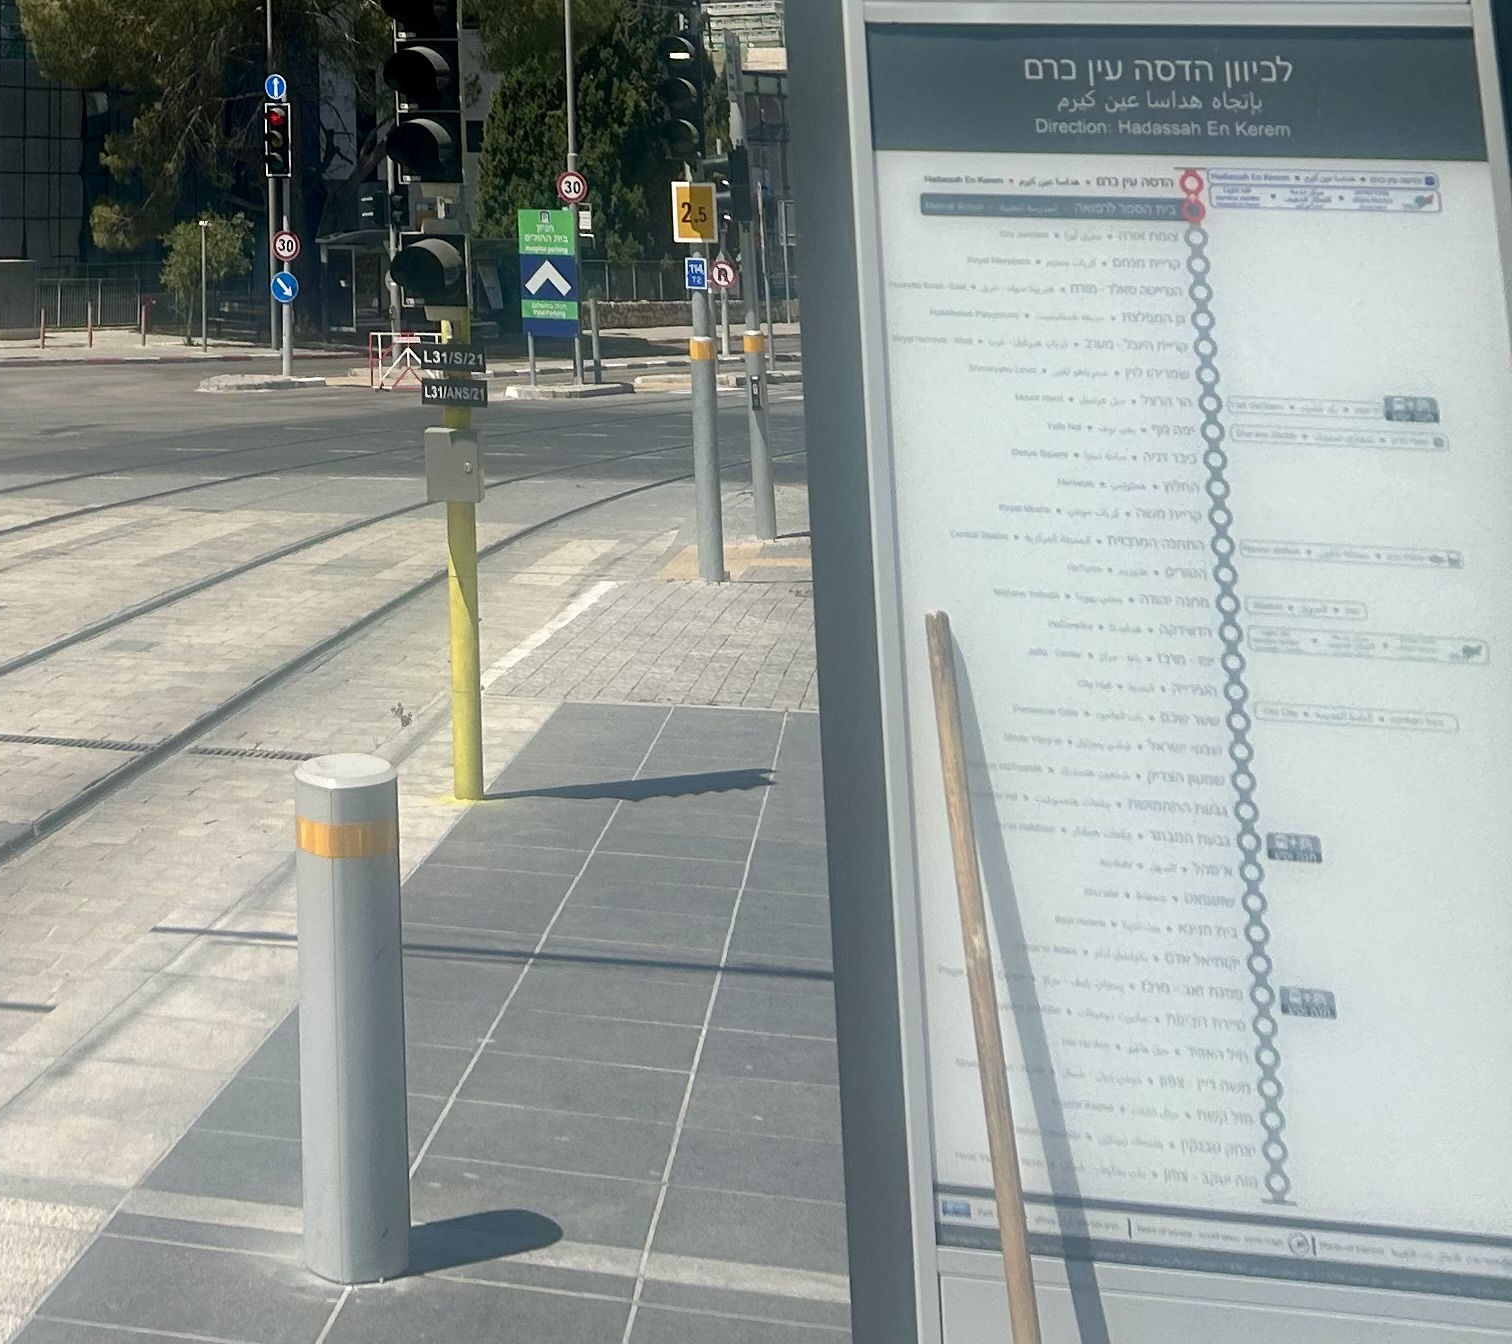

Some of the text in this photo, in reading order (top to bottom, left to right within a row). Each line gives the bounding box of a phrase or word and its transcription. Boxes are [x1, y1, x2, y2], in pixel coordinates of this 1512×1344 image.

[1025, 56, 1292, 88] לכיוון הדסה עין כרם
[1118, 119, 1201, 136] Hadassah
[1208, 121, 1230, 136] En
[1236, 121, 1291, 137] Kerem
[564, 180, 581, 194] 30
[681, 201, 707, 223] 2.5
[278, 238, 293, 252] 30
[423, 350, 483, 366] L31/S/21
[424, 386, 485, 401] L31/ANS/21
